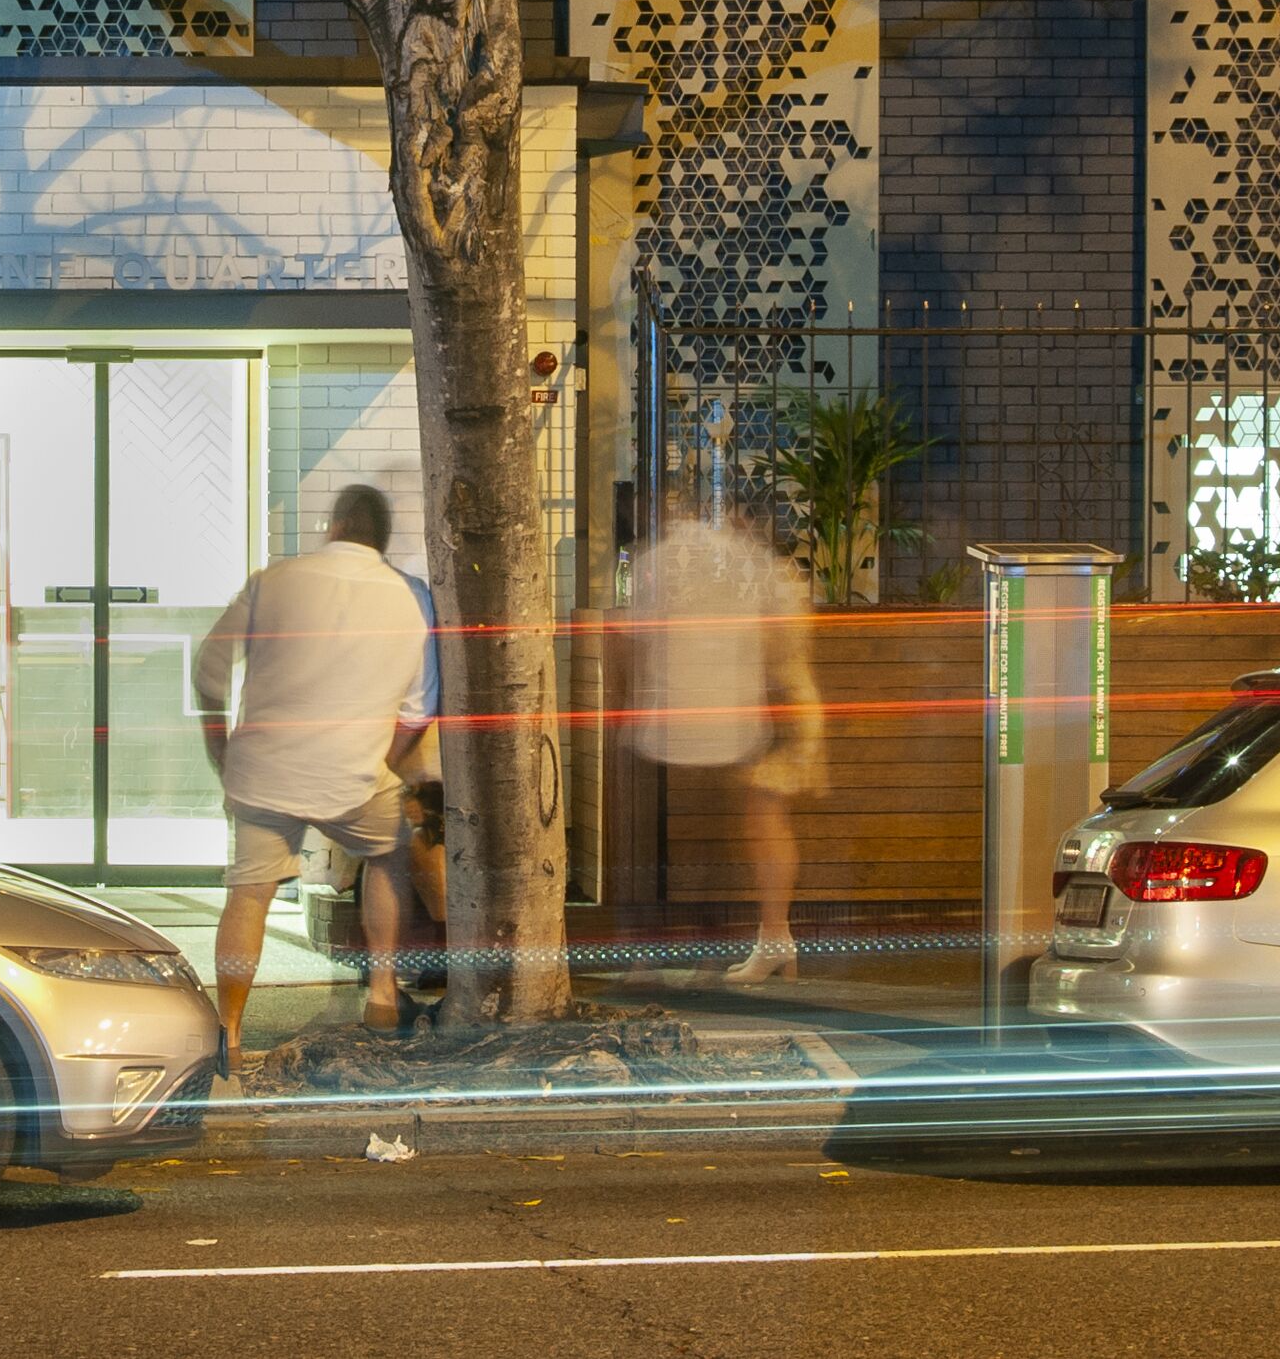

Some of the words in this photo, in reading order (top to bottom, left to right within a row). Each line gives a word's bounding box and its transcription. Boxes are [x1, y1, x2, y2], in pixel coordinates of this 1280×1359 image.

[536, 392, 555, 401] FIRE
[1001, 580, 1009, 625] REGISTER
[1097, 579, 1105, 622] REGISTER
[1000, 626, 1008, 651] HERE
[1097, 624, 1105, 649] HERE
[1000, 653, 1008, 674] FOR
[1097, 651, 1105, 672] FOR
[1000, 675, 1008, 688] 15
[1097, 673, 1105, 686] 15
[1000, 689, 1008, 732] MINUTES
[999, 734, 1008, 758] FREE
[1095, 732, 1104, 756] FREE
